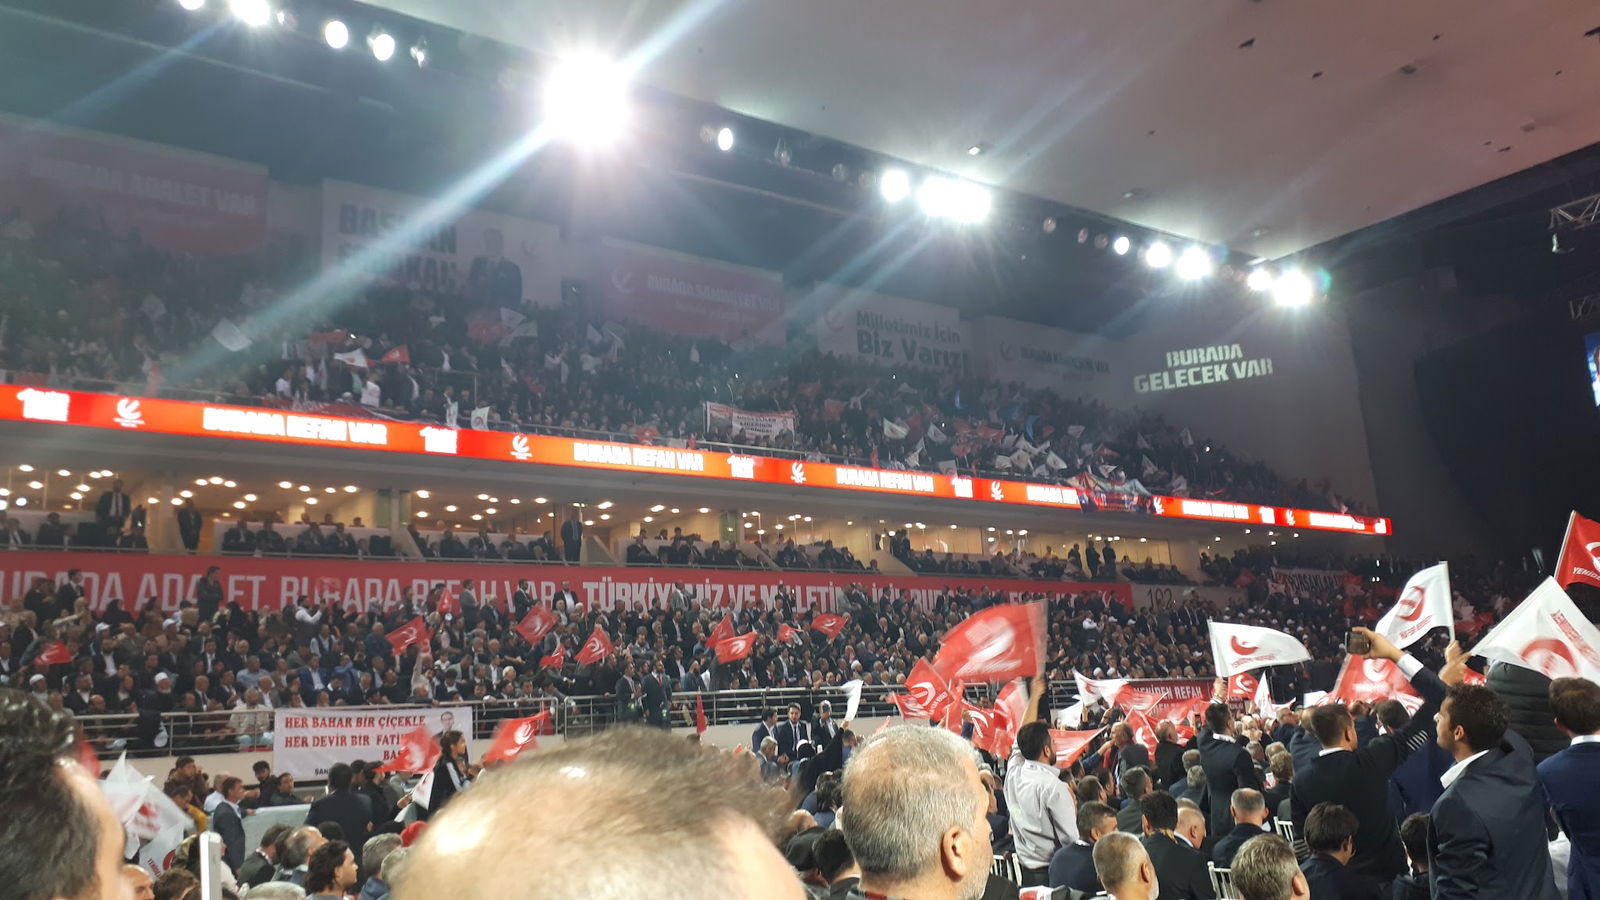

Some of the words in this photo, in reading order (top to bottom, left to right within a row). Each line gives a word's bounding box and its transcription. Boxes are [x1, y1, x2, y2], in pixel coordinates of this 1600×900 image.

[857, 329, 895, 359] Biz
[1166, 344, 1243, 368] BURADA
[1133, 363, 1229, 393] GELECEK
[1232, 357, 1273, 380] VAR
[1174, 686, 1203, 700] REFAH
[285, 717, 308, 728] HER
[312, 717, 352, 728] BAHAR
[356, 714, 375, 728] BİR
[378, 714, 426, 729] ÇİÇEKLE
[285, 736, 308, 748] HER
[312, 733, 347, 747] DEVİR
[376, 733, 404, 745] FATİ
